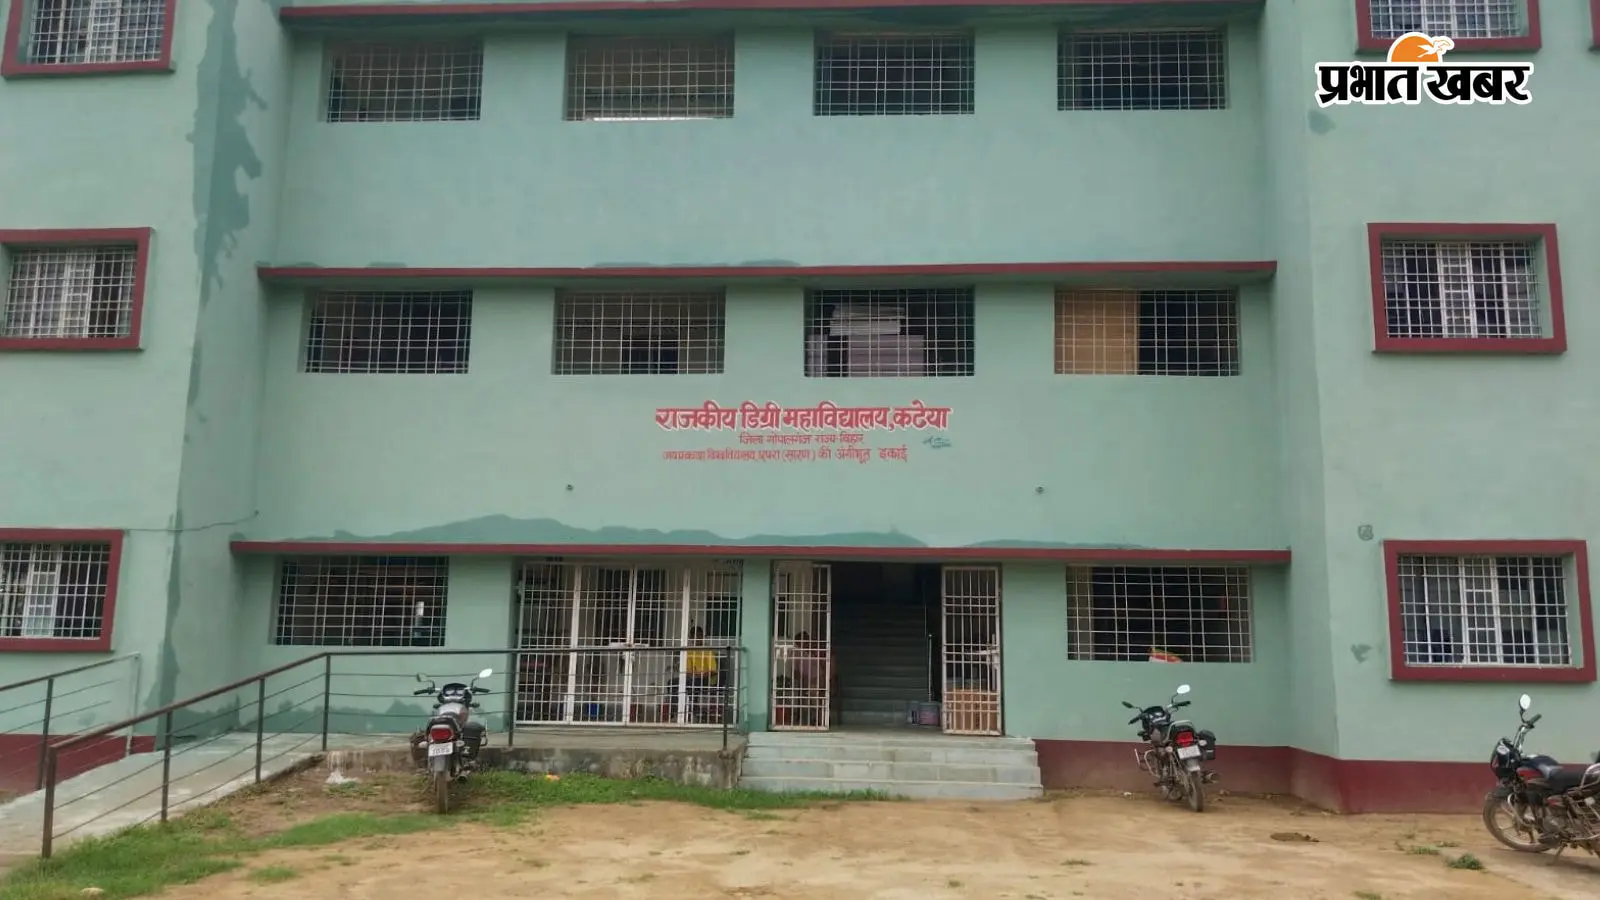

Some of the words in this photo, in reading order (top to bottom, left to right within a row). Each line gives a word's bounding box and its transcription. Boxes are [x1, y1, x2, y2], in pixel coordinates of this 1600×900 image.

[656, 401, 738, 430] राजकीय
[740, 401, 781, 429] डिग्री
[739, 432, 763, 444] जिला
[819, 446, 832, 460] की
